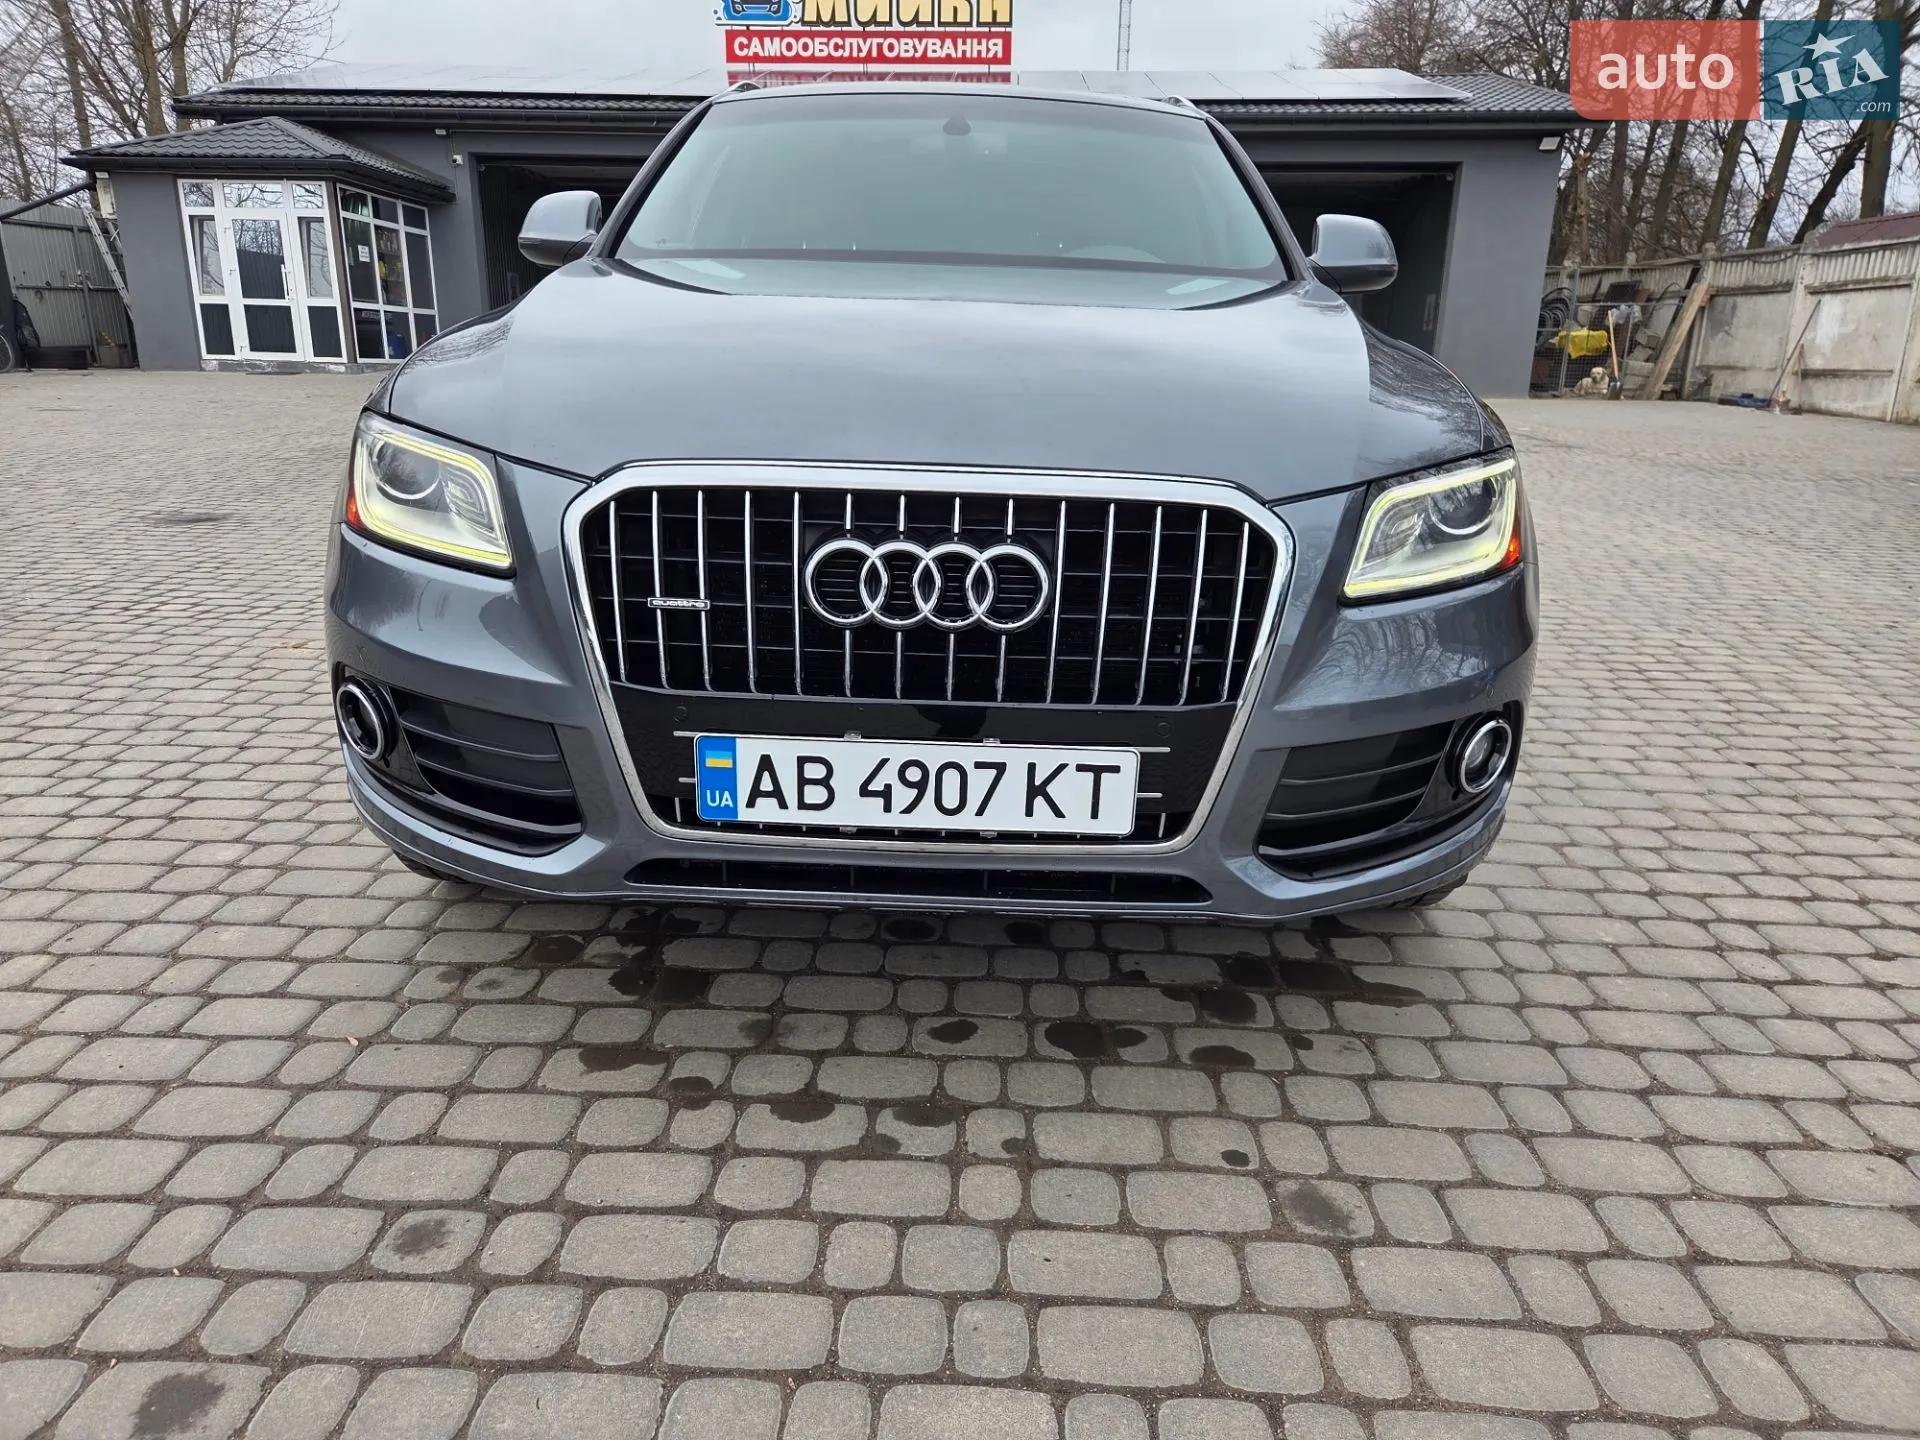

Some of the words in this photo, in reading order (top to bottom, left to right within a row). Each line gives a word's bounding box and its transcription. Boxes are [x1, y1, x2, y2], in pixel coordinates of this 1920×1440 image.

[733, 36, 1003, 58] САМООБСЛУГОВУВАННЯ
[745, 753, 836, 811] AB
[858, 757, 1007, 817] 4907
[1024, 761, 1122, 820] KT
[706, 789, 734, 808] UA
